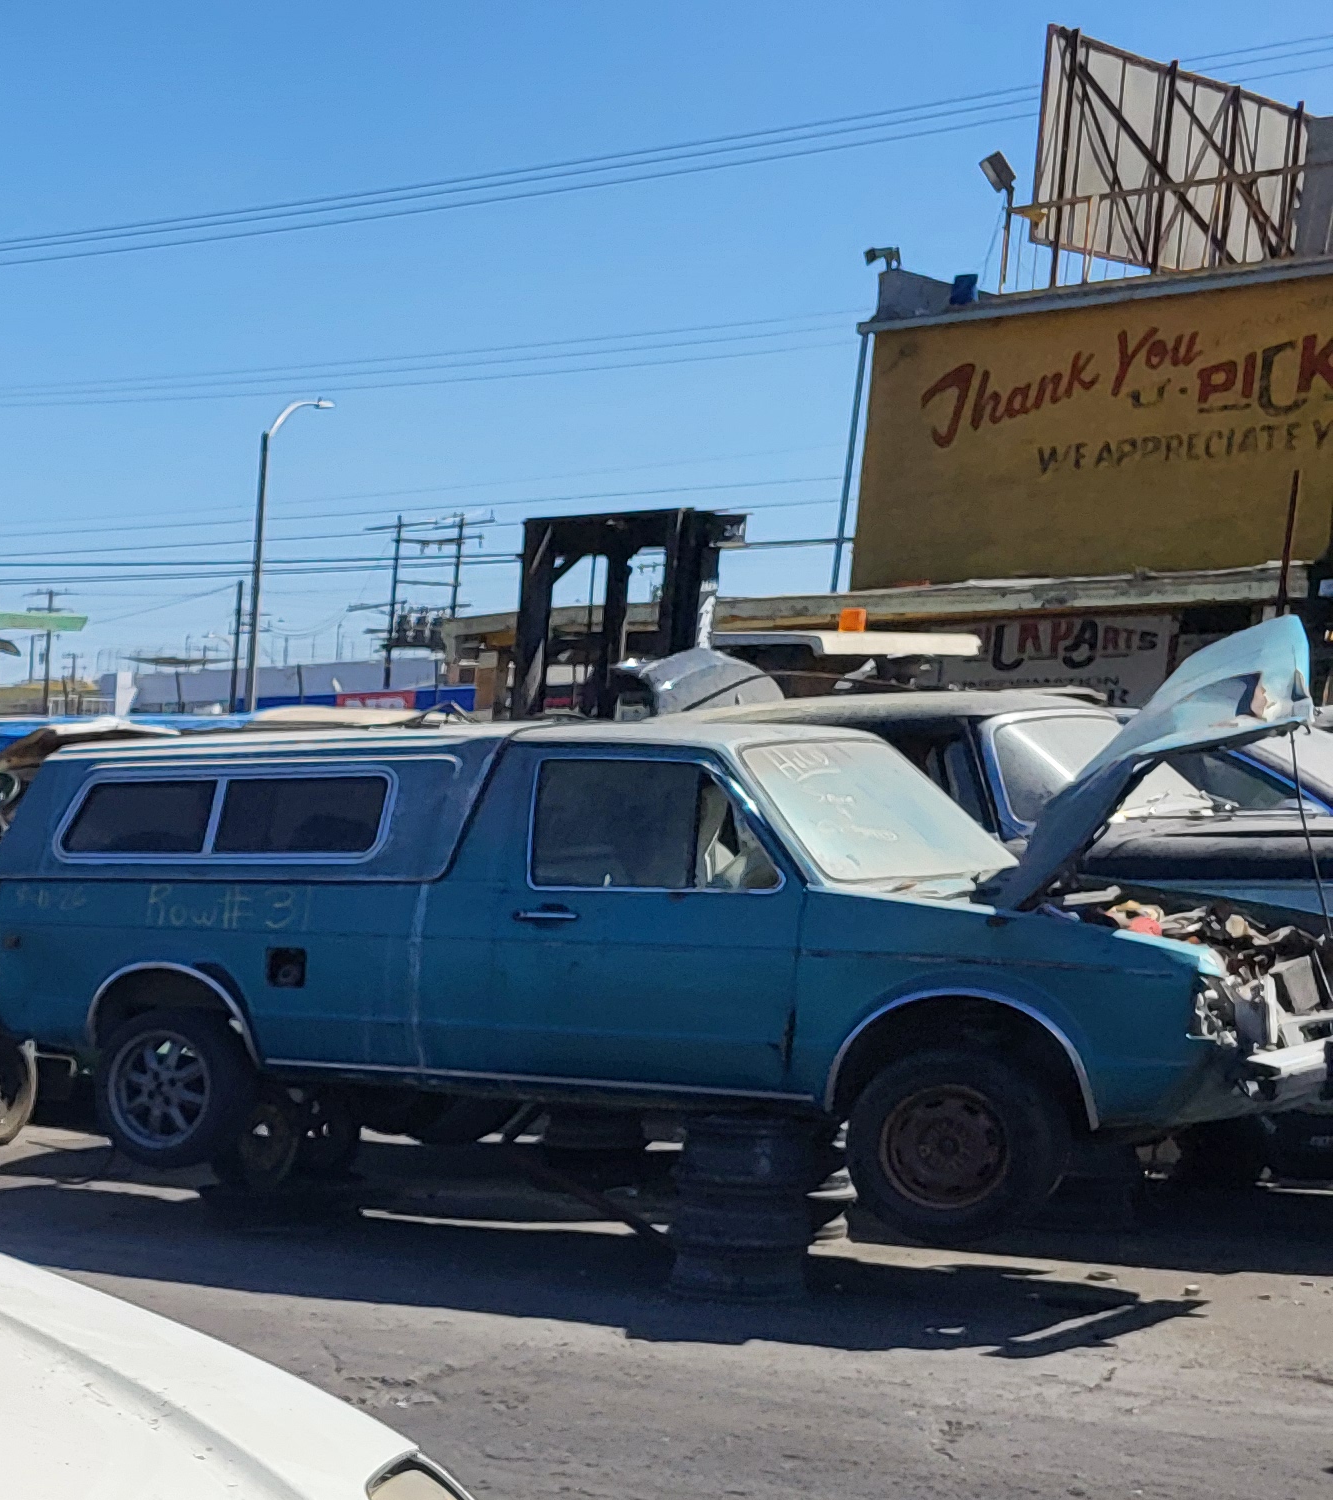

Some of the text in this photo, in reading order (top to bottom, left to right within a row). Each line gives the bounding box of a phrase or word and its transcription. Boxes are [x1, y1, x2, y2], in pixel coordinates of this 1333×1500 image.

[921, 326, 1203, 448] Thank You
[1094, 421, 1301, 468] APPRECIATE
